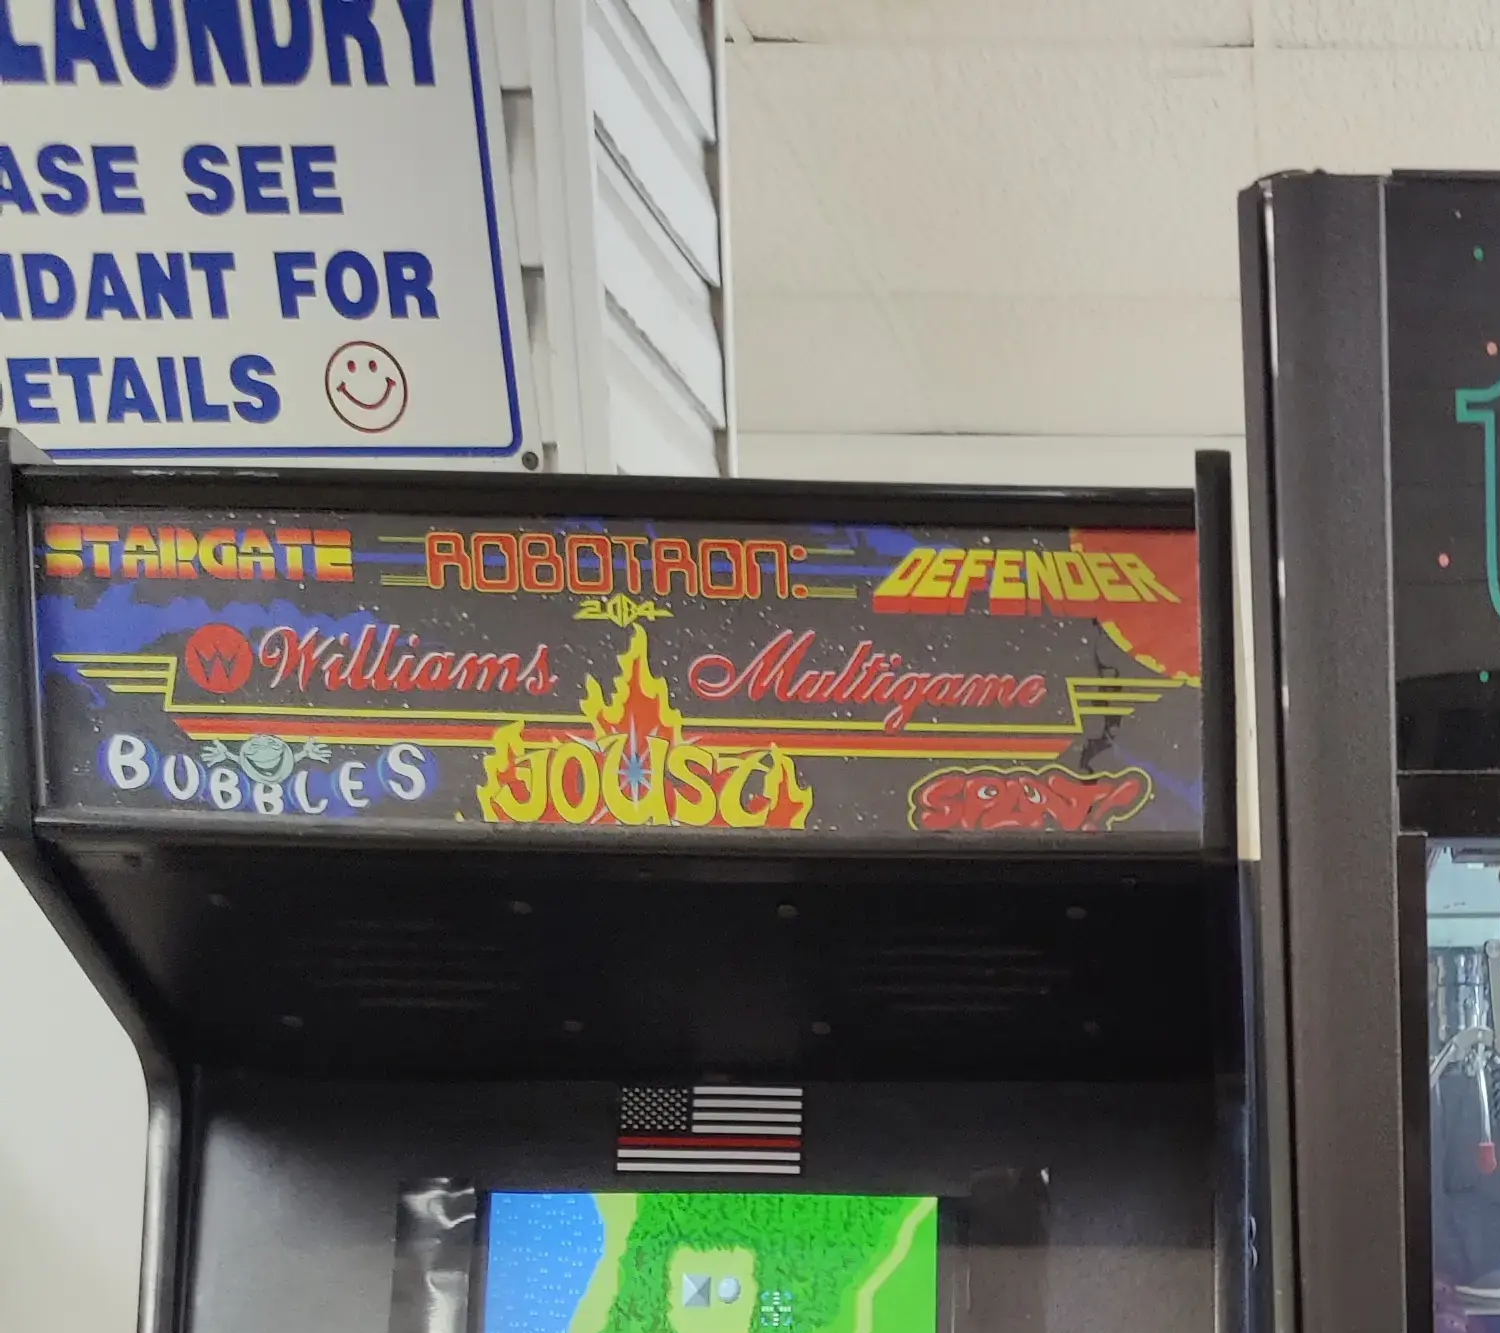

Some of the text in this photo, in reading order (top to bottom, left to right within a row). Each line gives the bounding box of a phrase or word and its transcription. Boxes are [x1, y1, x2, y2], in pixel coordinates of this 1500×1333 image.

[182, 143, 344, 216] SEE
[273, 250, 440, 320] FOR
[0, 354, 282, 425] ETAILS
[45, 524, 354, 581] STARGATE
[873, 548, 1182, 617] DEFENDER
[259, 624, 560, 695] Williams
[688, 629, 1047, 734] Multigame
[107, 733, 427, 816] BUBBLES
